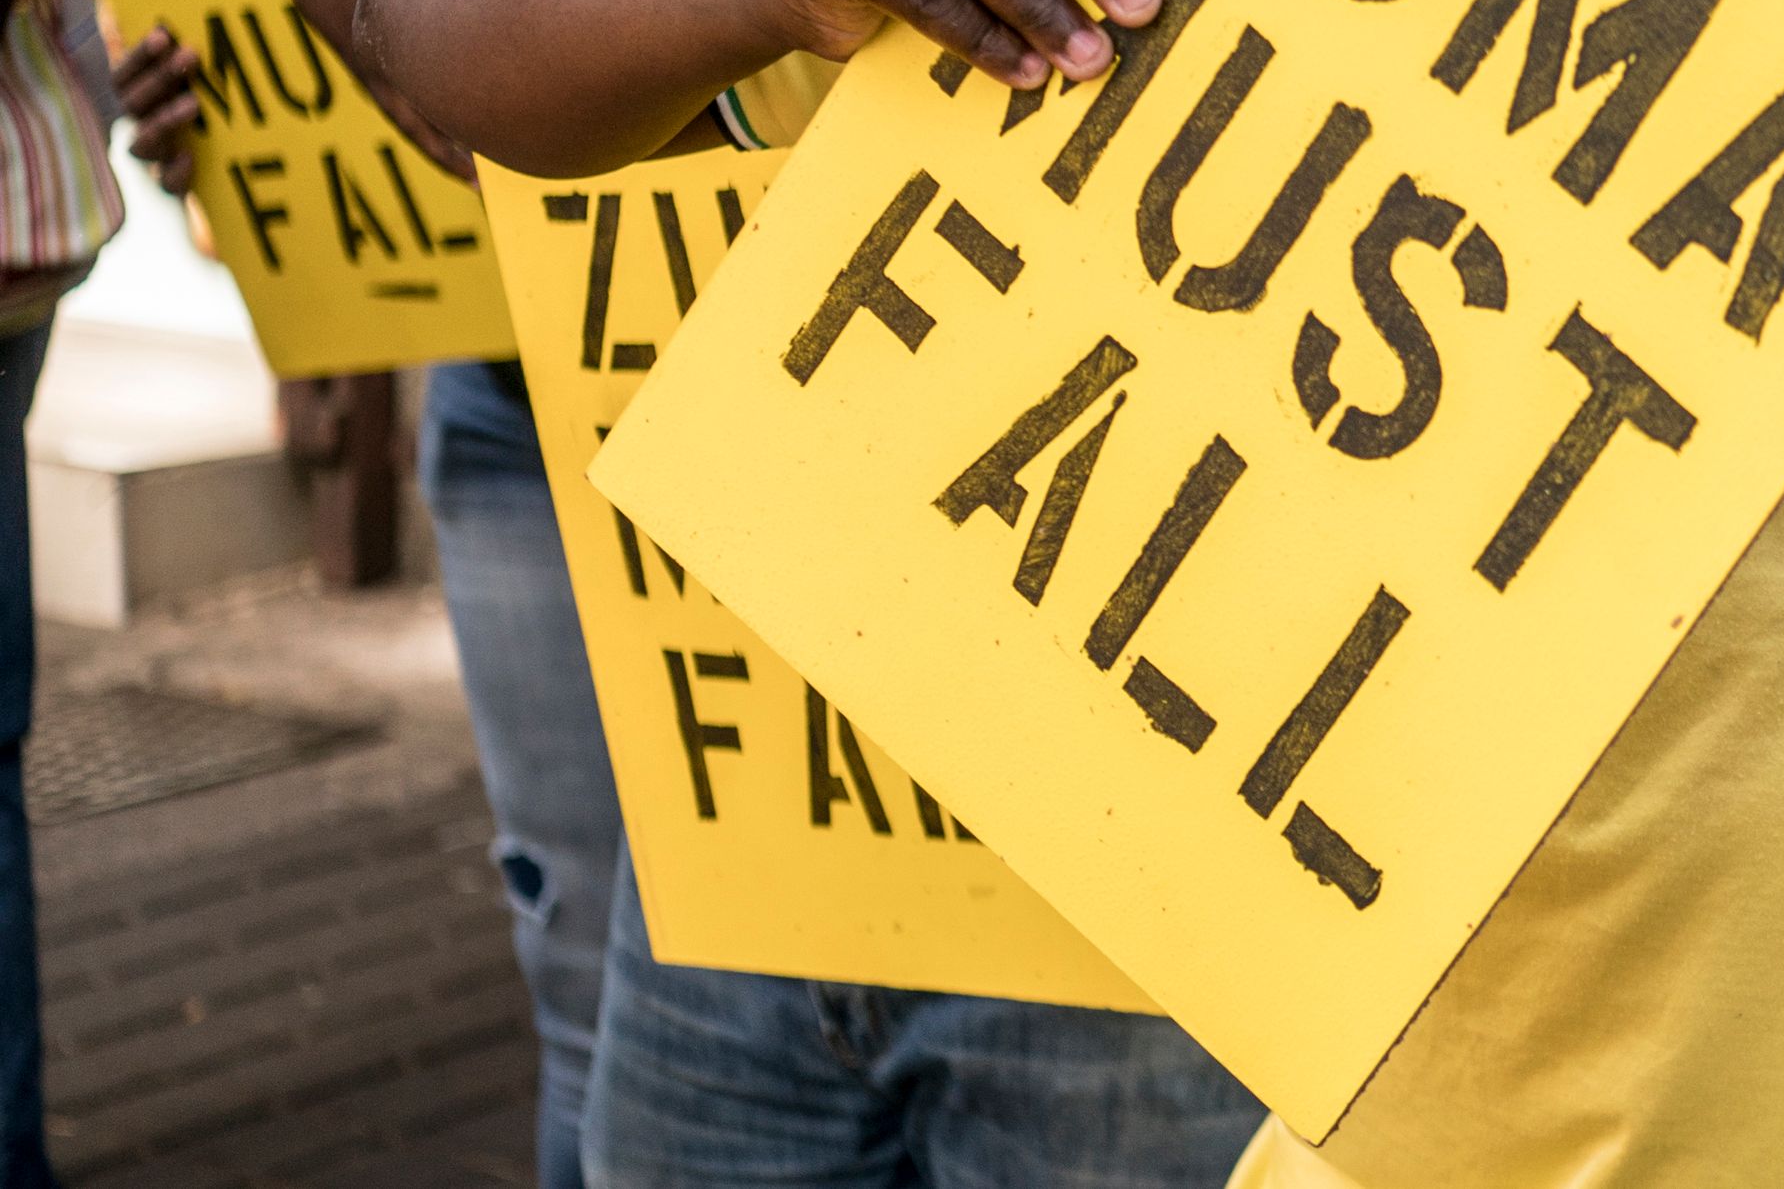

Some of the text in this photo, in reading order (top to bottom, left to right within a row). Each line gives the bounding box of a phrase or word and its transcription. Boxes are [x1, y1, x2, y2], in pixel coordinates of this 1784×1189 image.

[158, 5, 332, 134] MU
[229, 141, 477, 274] FAL
[781, 168, 1411, 911] FALL
